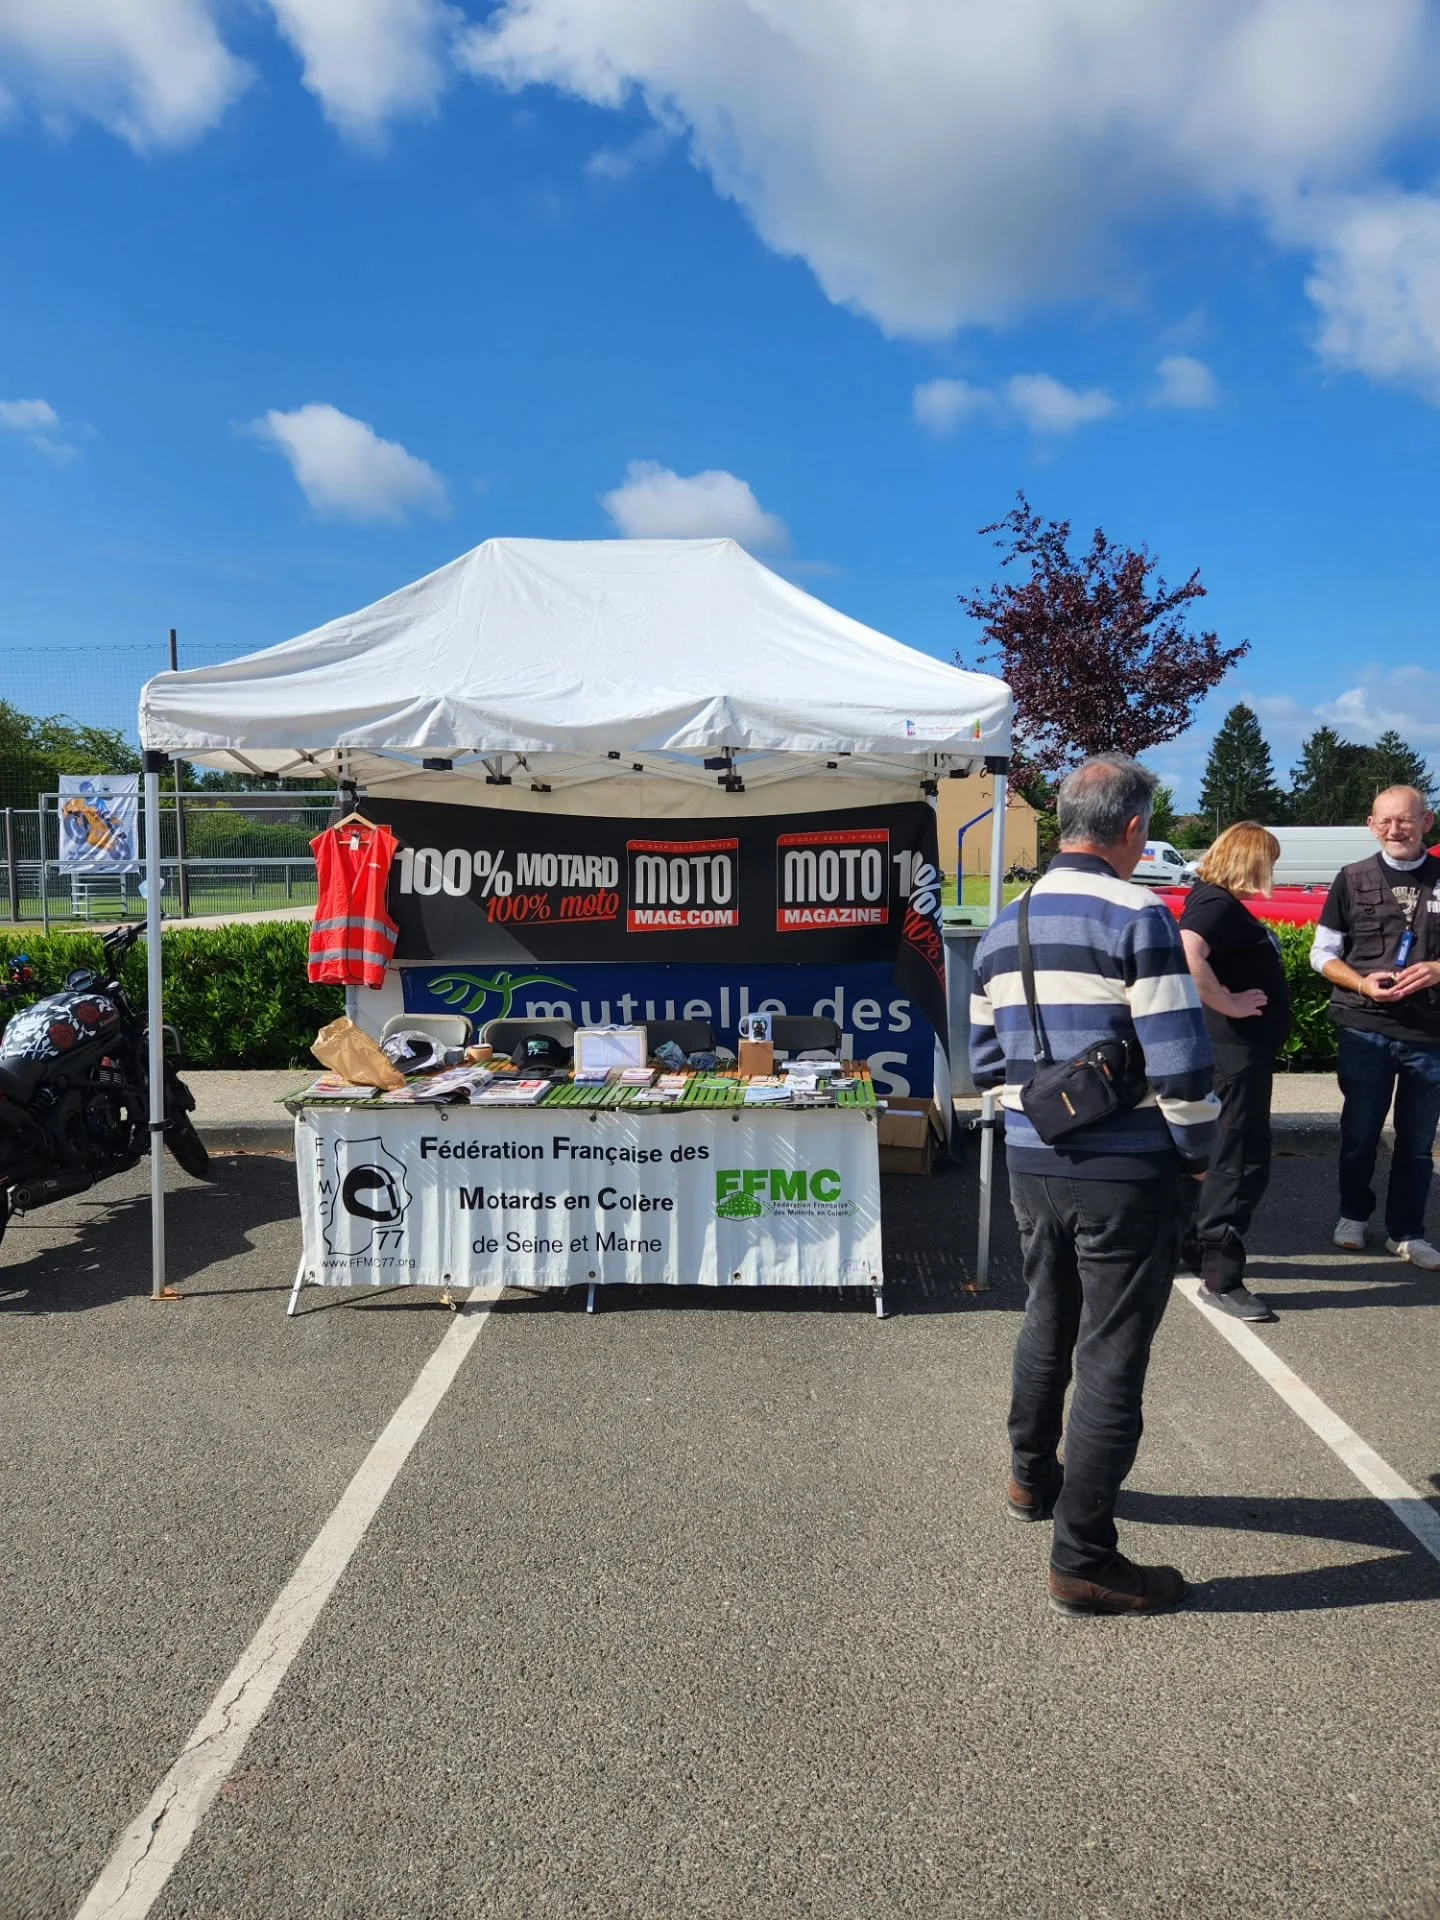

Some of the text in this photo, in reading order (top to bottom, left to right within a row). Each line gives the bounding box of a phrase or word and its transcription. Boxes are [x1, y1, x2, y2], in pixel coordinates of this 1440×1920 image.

[394, 847, 618, 897] 100% MOTARD
[635, 855, 732, 905] MOTO
[784, 849, 882, 902] MOTO
[486, 888, 619, 923] 100% moto
[635, 909, 733, 925] MAG.COM
[784, 909, 881, 923] MAGAZINE
[525, 986, 912, 1033] mutuelle des
[420, 1136, 710, 1165] Fédération Française des
[459, 1186, 674, 1212] Motards en Colère
[716, 1168, 842, 1202] FFMC
[376, 1230, 405, 1251] 77
[472, 1231, 662, 1254] de Seine et Marne
